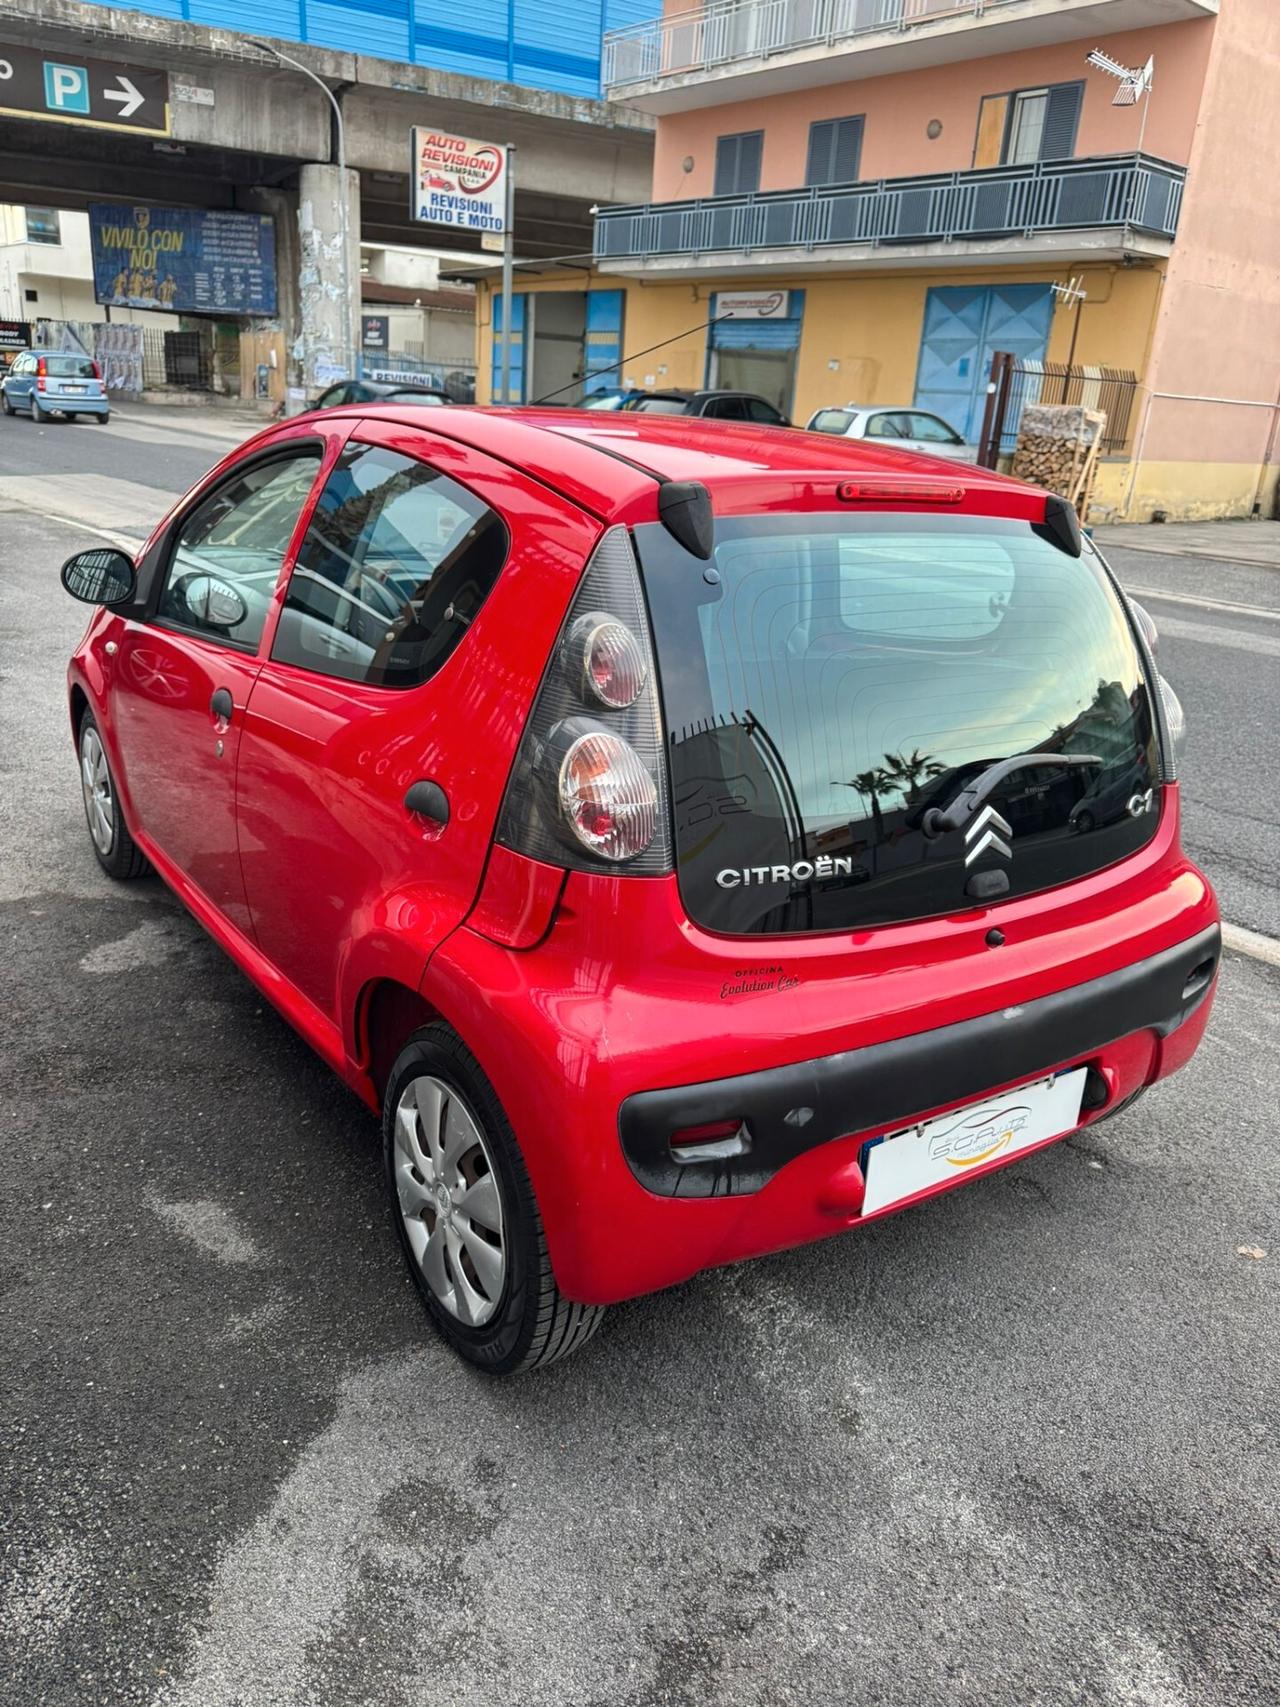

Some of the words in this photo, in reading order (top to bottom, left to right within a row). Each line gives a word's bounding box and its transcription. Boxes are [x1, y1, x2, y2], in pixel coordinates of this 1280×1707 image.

[53, 66, 82, 107] P
[426, 135, 466, 152] AUTO
[422, 147, 495, 171] REVISIONI
[443, 164, 487, 180] CAMPANIA
[430, 192, 493, 215] REVISIONI
[420, 205, 453, 223] AUTO
[456, 211, 465, 225] E
[468, 213, 503, 231] MOTO
[151, 229, 184, 253] CON
[130, 248, 158, 270] NOI
[375, 372, 430, 387] REVISIONI
[715, 854, 852, 889] CITROËN
[734, 965, 784, 978] OFFICINA
[720, 980, 774, 999] Evolution
